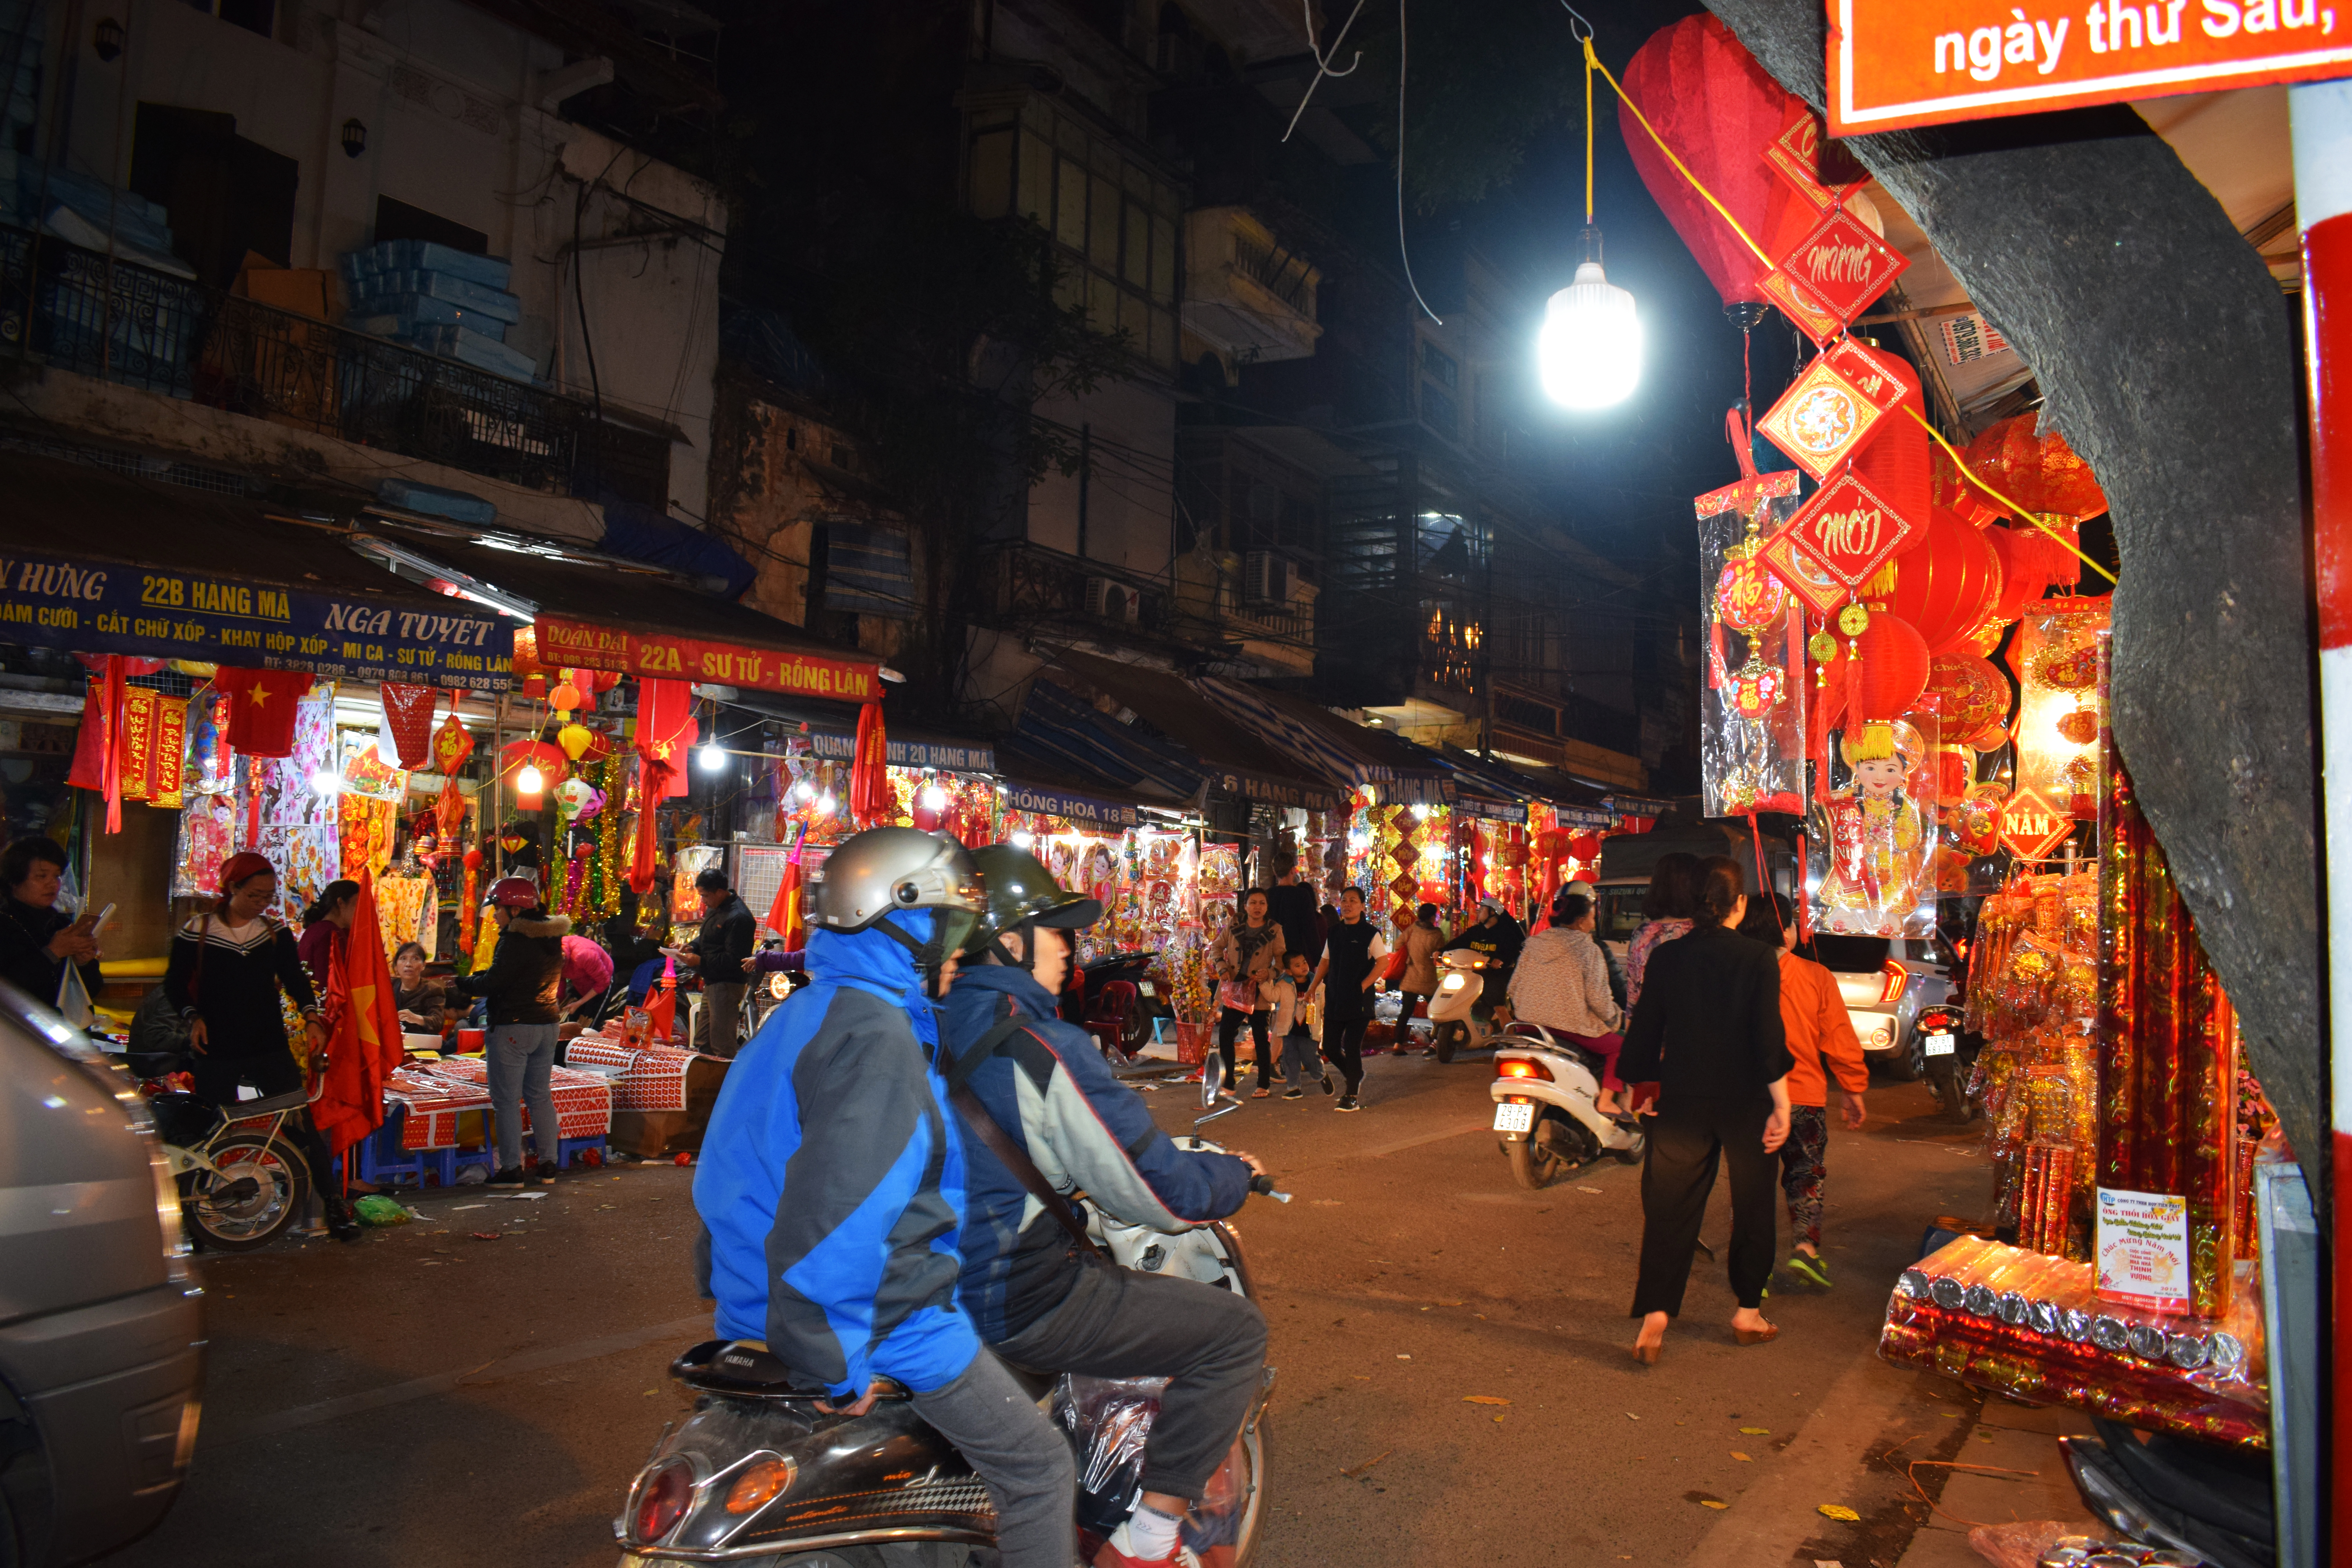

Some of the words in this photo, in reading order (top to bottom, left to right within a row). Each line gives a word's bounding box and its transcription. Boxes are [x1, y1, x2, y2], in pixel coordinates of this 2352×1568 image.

[1935, 8, 2069, 81] ngày
[18, 563, 107, 601] HƯNG
[142, 575, 184, 606] 22B
[192, 579, 251, 614] HÀNG
[324, 604, 392, 635] NGA
[38, 607, 78, 629] CƯỚI
[97, 609, 130, 634] CẮT
[134, 617, 170, 638] CHỮ
[173, 619, 205, 642] XỐP
[221, 628, 261, 648] KHAY
[265, 631, 296, 654] HỘP
[299, 633, 328, 655] XỐP
[343, 642, 362, 659] MI
[366, 644, 384, 661] CA
[397, 648, 416, 664] SƯ
[418, 646, 436, 666] TỬ
[446, 649, 482, 671] RỒNG
[486, 654, 512, 673] LÂN
[317, 662, 346, 675] 0286
[440, 674, 467, 687] 0982
[470, 677, 490, 689] 628
[640, 644, 682, 672] 22A
[702, 652, 733, 678] SƯ
[736, 650, 762, 682] TỬ
[779, 657, 831, 691] RỒNG
[835, 667, 868, 696] LÂN
[1941, 715, 1957, 723] ăm
[440, 731, 457, 757] 福
[910, 745, 926, 764] 20
[930, 745, 965, 767] HÀNG
[1009, 788, 1057, 813] HỒNG
[1063, 800, 1097, 819] HOA
[1103, 808, 1120, 823] 18
[2005, 808, 2049, 836] NĂM
[1609, 887, 1635, 896] SUZUKI
[1636, 887, 1649, 895] QU
[1499, 1118, 1526, 1130] 4308
[1501, 1105, 1528, 1117] 29-P4
[2102, 1194, 2115, 1203] HTP
[2102, 1241, 2118, 1257] Chúc
[2118, 1237, 2143, 1246] Mừng
[2146, 1239, 2165, 1252] Năm
[2165, 1250, 2181, 1266] Mới
[724, 1355, 754, 1367] YAMAHA
[883, 1470, 915, 1481] mio
[786, 1505, 850, 1522] automatic
